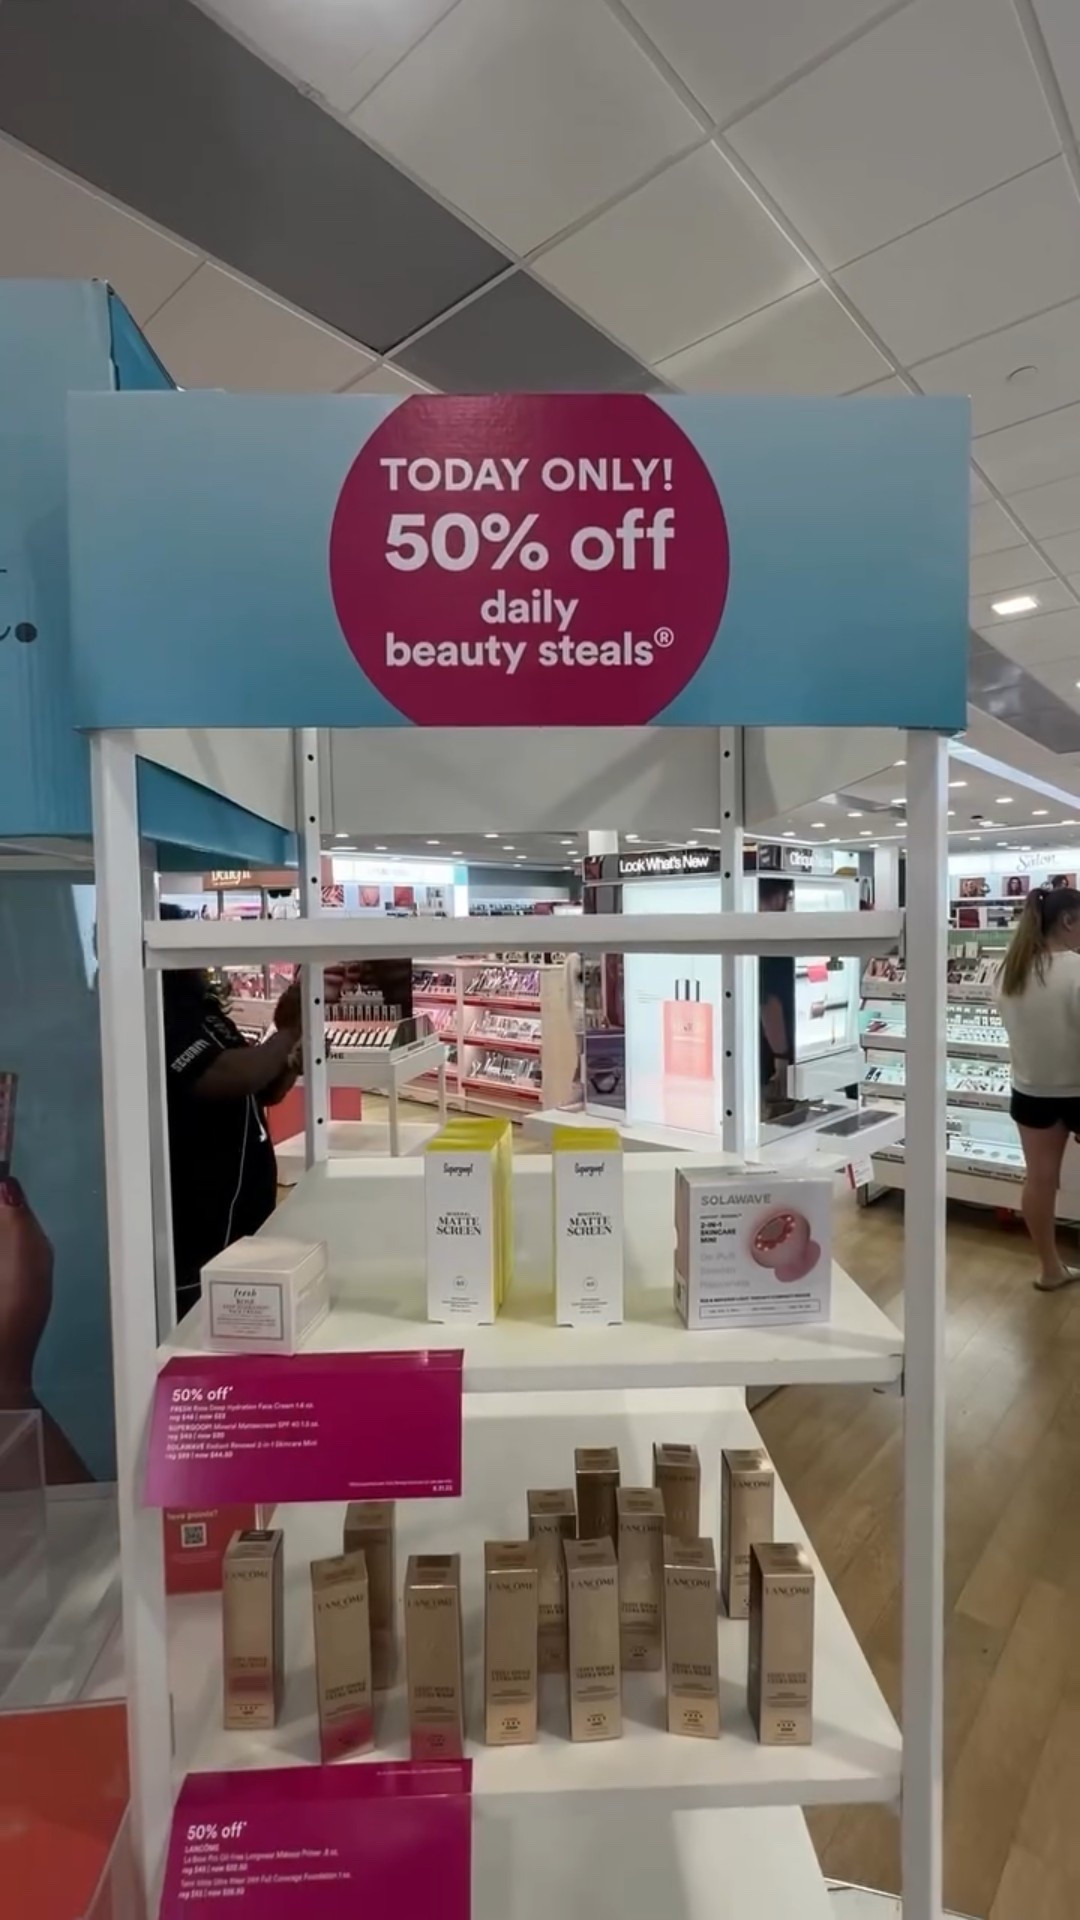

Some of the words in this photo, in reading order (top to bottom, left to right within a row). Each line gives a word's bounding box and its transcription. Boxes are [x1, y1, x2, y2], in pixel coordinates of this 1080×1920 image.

[379, 457, 530, 492] TODAY
[541, 457, 673, 492] ONLY!
[385, 512, 549, 572] 50%
[570, 507, 676, 572] off
[480, 588, 579, 632] daily
[386, 632, 527, 674] beauty
[619, 859, 644, 873] Look
[645, 856, 682, 871] What's
[683, 854, 709, 868] New
[700, 1193, 771, 1206] SOLAWAVE
[438, 1216, 479, 1226] MATTE
[569, 1216, 610, 1226] MATTE
[436, 1226, 482, 1236] SCREEN
[566, 1226, 612, 1236] SCREEN
[172, 1388, 203, 1402] 50%
[187, 1823, 218, 1841] 50%
